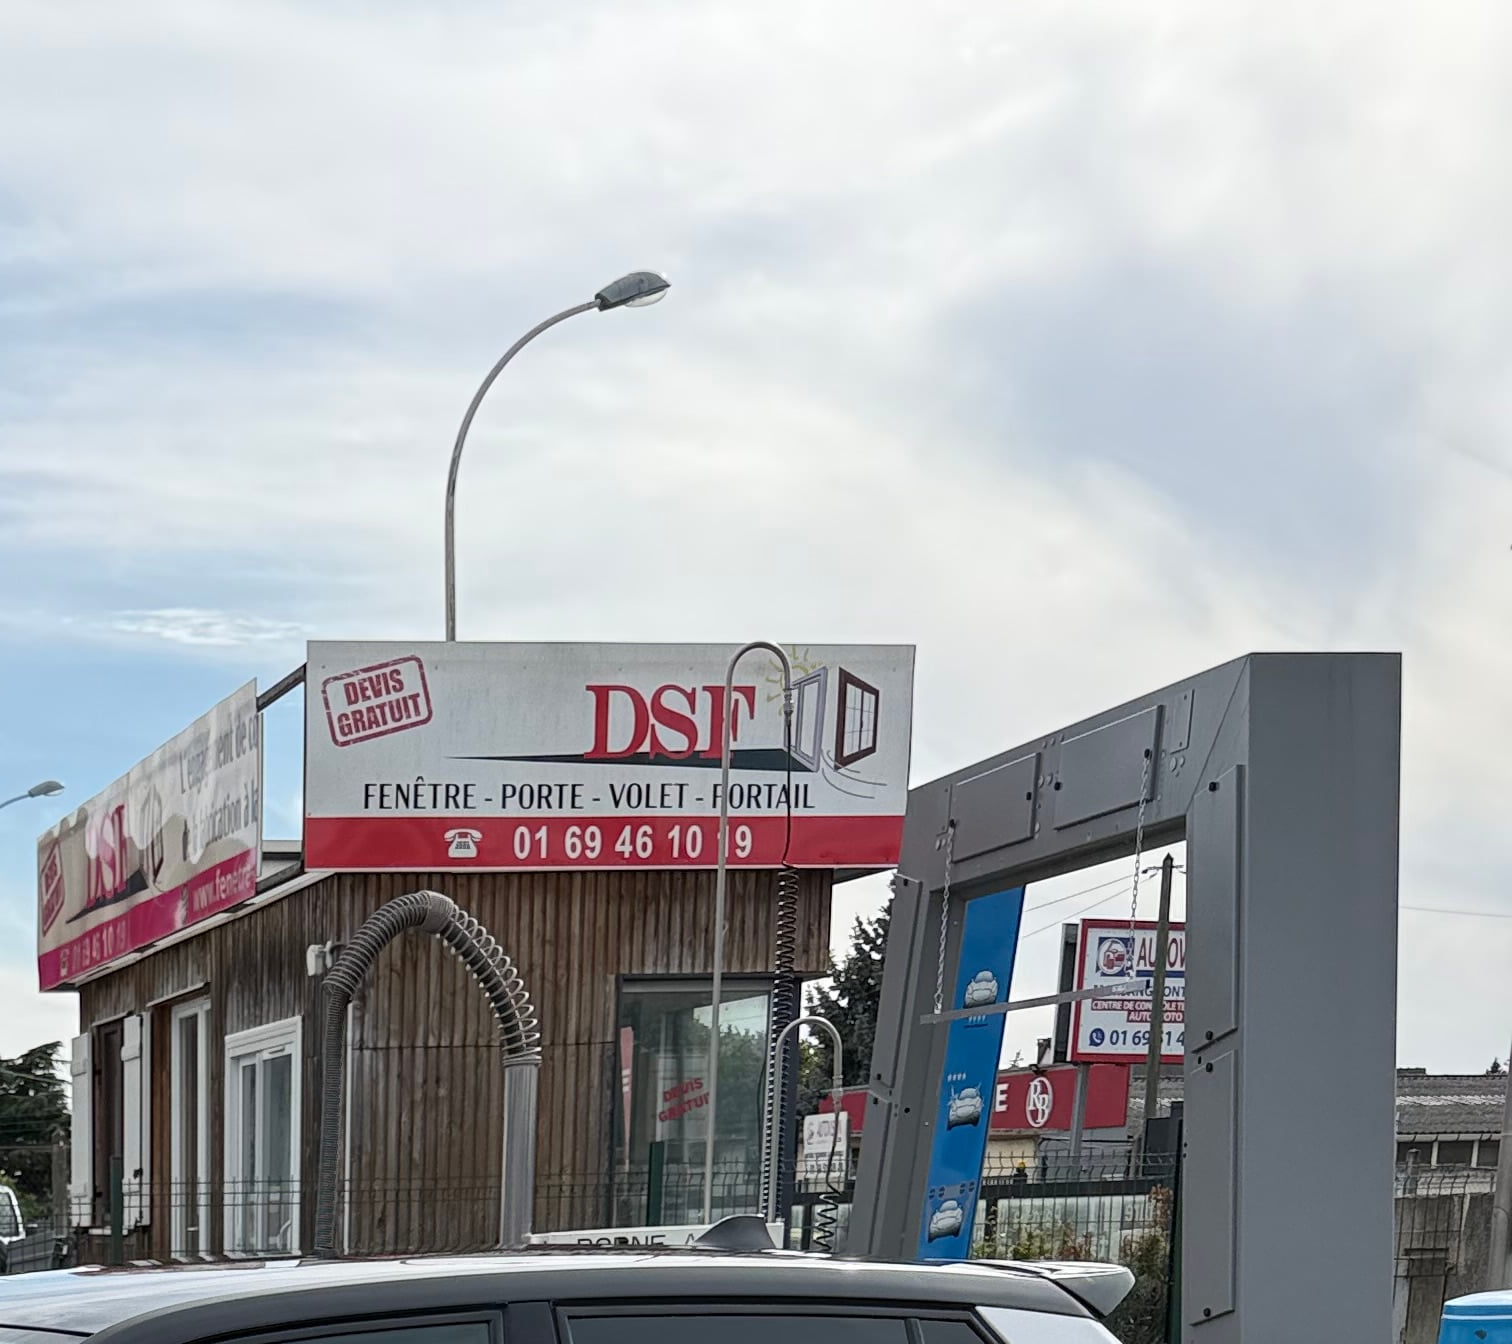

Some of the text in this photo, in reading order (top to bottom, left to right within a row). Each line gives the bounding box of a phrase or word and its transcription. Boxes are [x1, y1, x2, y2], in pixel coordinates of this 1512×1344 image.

[344, 669, 404, 706] DEVIS
[337, 692, 421, 737] GRATUIT
[584, 684, 756, 760] DSF
[364, 776, 477, 809] FENÊTRE
[501, 784, 584, 809] PORTE
[609, 783, 689, 809] VOLET
[514, 825, 548, 859] 01
[564, 825, 602, 860] 69
[615, 825, 653, 859] 46
[668, 825, 702, 859] 10
[1092, 1000, 1123, 1010] CENTRE
[1123, 1001, 1133, 1010] DE
[1110, 1030, 1128, 1046] 01
[1132, 1030, 1150, 1046] 69
[664, 1077, 703, 1102] DEVIS
